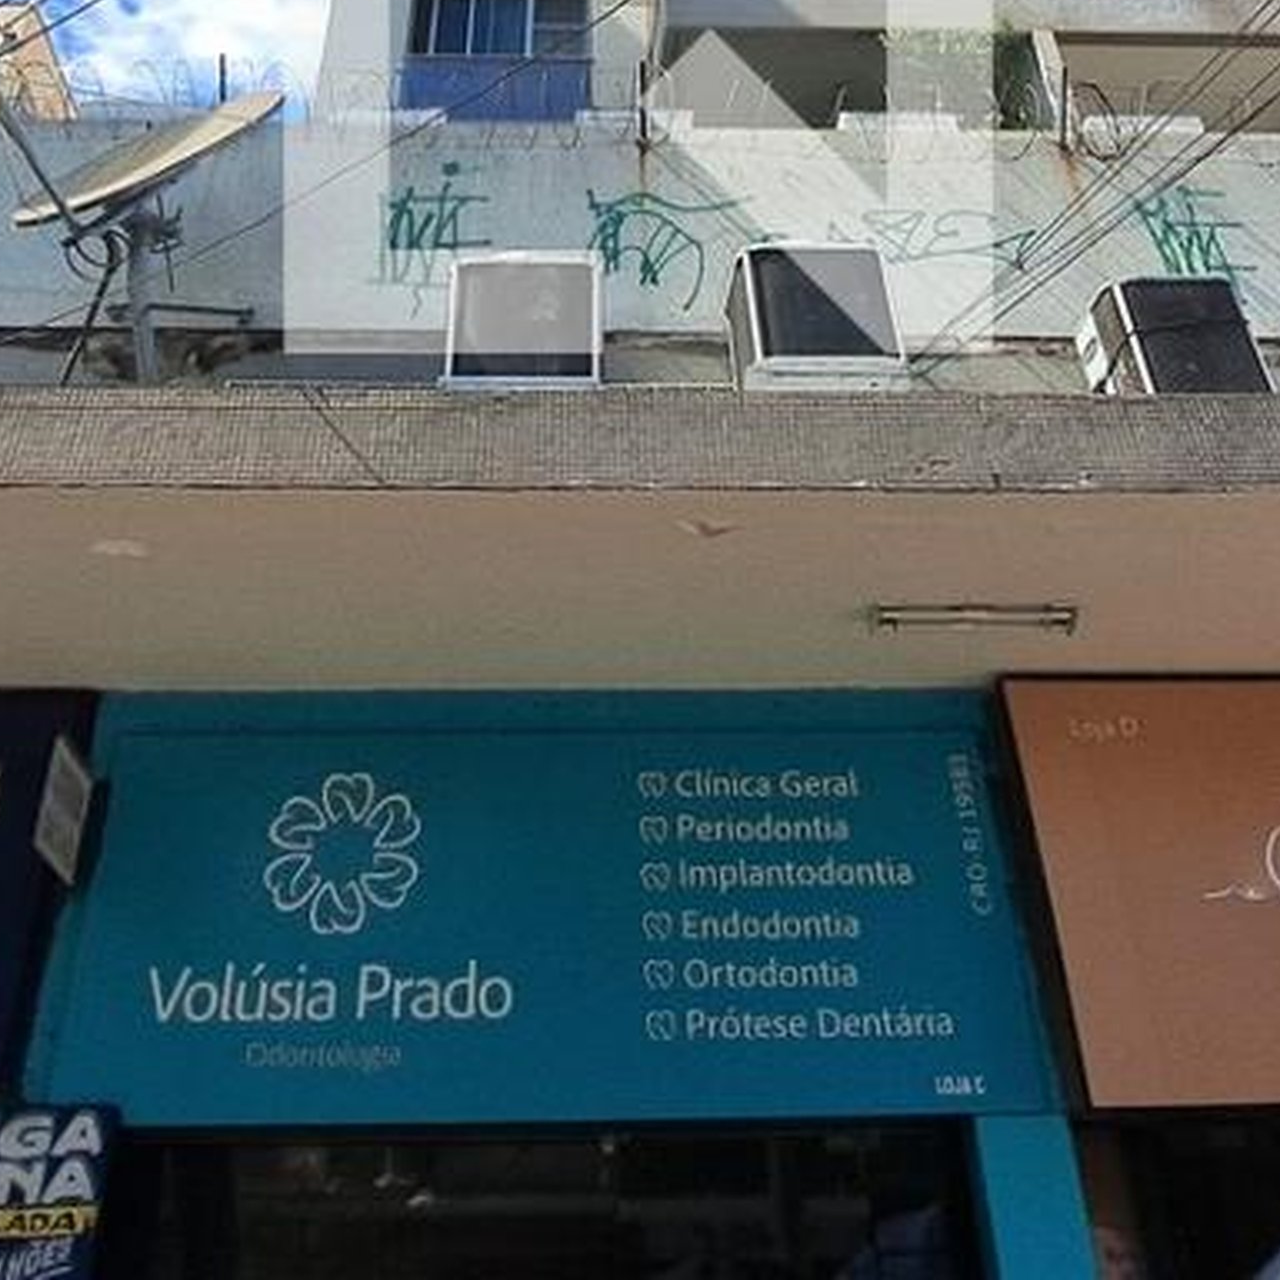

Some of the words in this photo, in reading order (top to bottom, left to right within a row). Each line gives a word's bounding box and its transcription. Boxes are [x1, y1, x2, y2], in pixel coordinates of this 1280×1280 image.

[674, 770, 770, 799] Clínica
[779, 770, 859, 799] Geral
[676, 814, 850, 843] Periodontia
[678, 858, 915, 893] Implantodontia
[681, 910, 860, 940] Endodontia
[682, 958, 859, 989] Ortodontia
[149, 960, 336, 1022] Volúsia
[356, 959, 513, 1020] Prado
[685, 1005, 808, 1039] Prótese
[818, 1005, 955, 1038] Dentária
